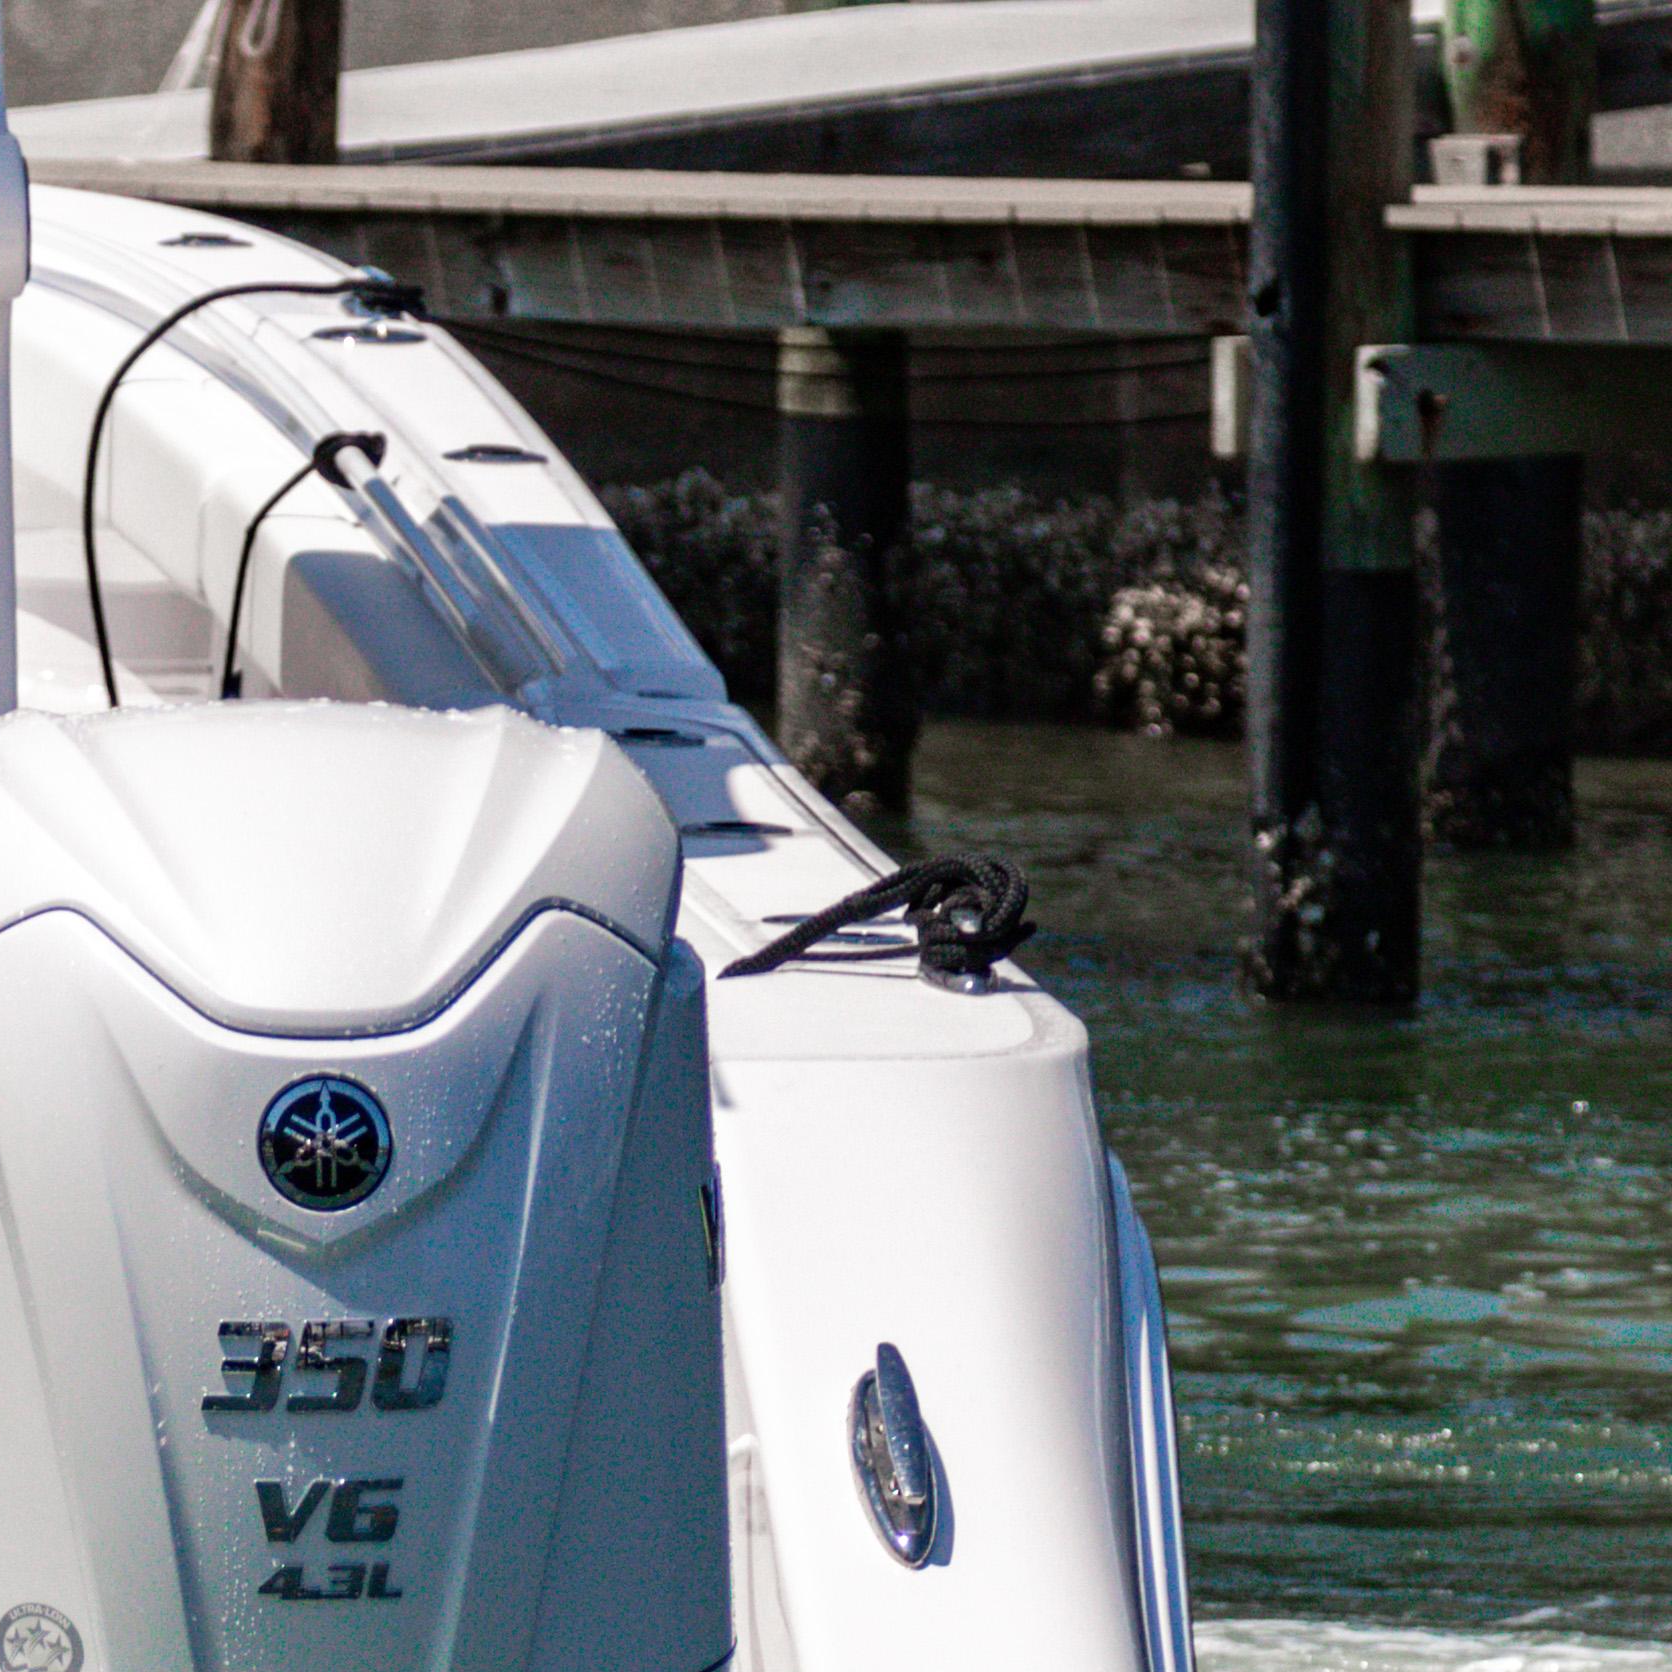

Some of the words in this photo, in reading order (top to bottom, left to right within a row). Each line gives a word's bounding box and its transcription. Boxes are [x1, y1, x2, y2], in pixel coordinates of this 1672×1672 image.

[201, 1317, 454, 1412] 350
[254, 1476, 405, 1543] V6
[258, 1561, 404, 1600] 4.3L
